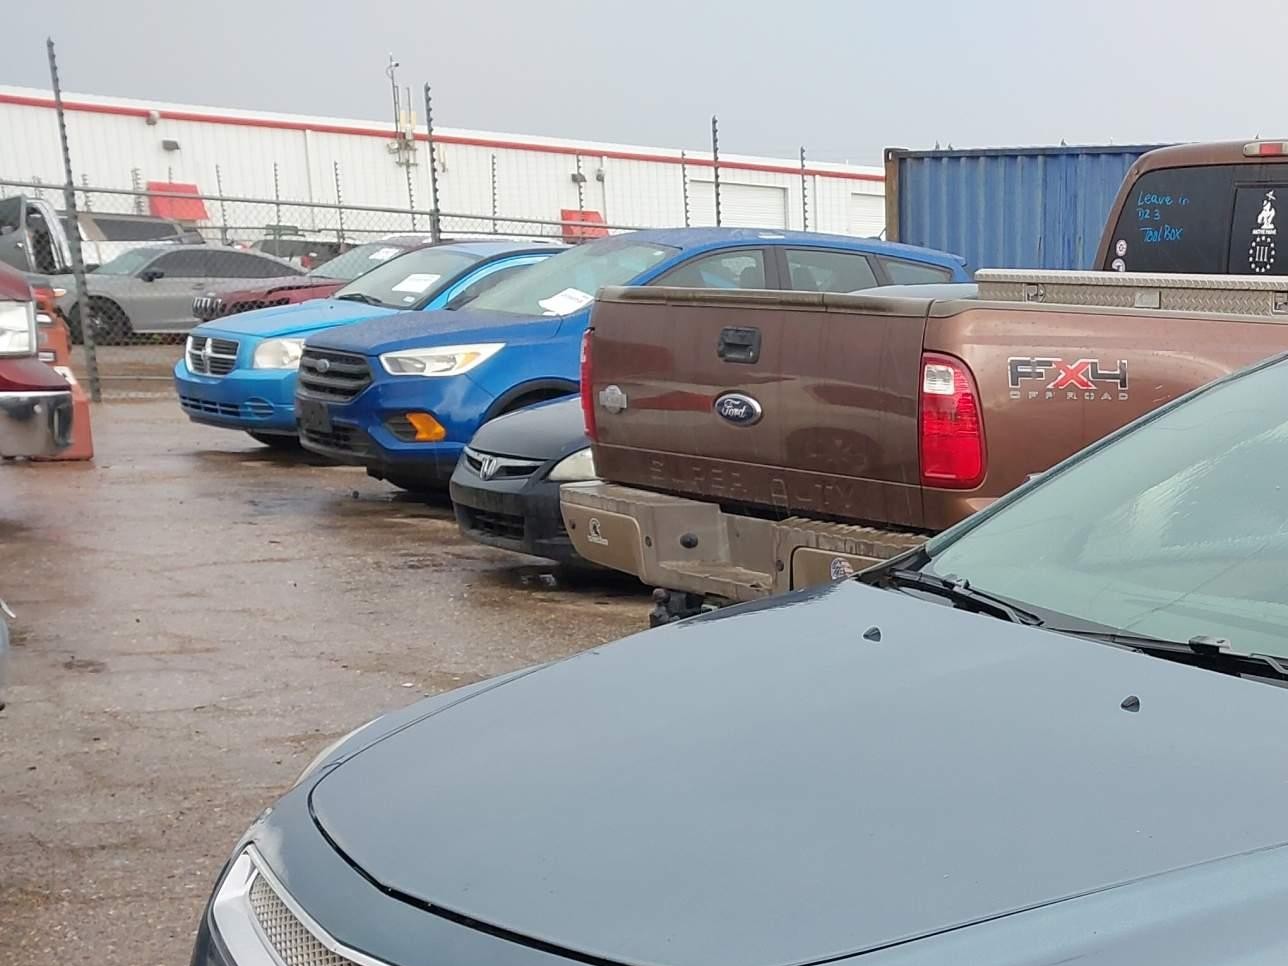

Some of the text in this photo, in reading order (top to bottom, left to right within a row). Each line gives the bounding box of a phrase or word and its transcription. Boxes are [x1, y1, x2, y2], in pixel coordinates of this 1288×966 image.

[1137, 191, 1173, 206] Leave
[1008, 356, 1128, 390] FX4
[720, 398, 746, 418] Ford
